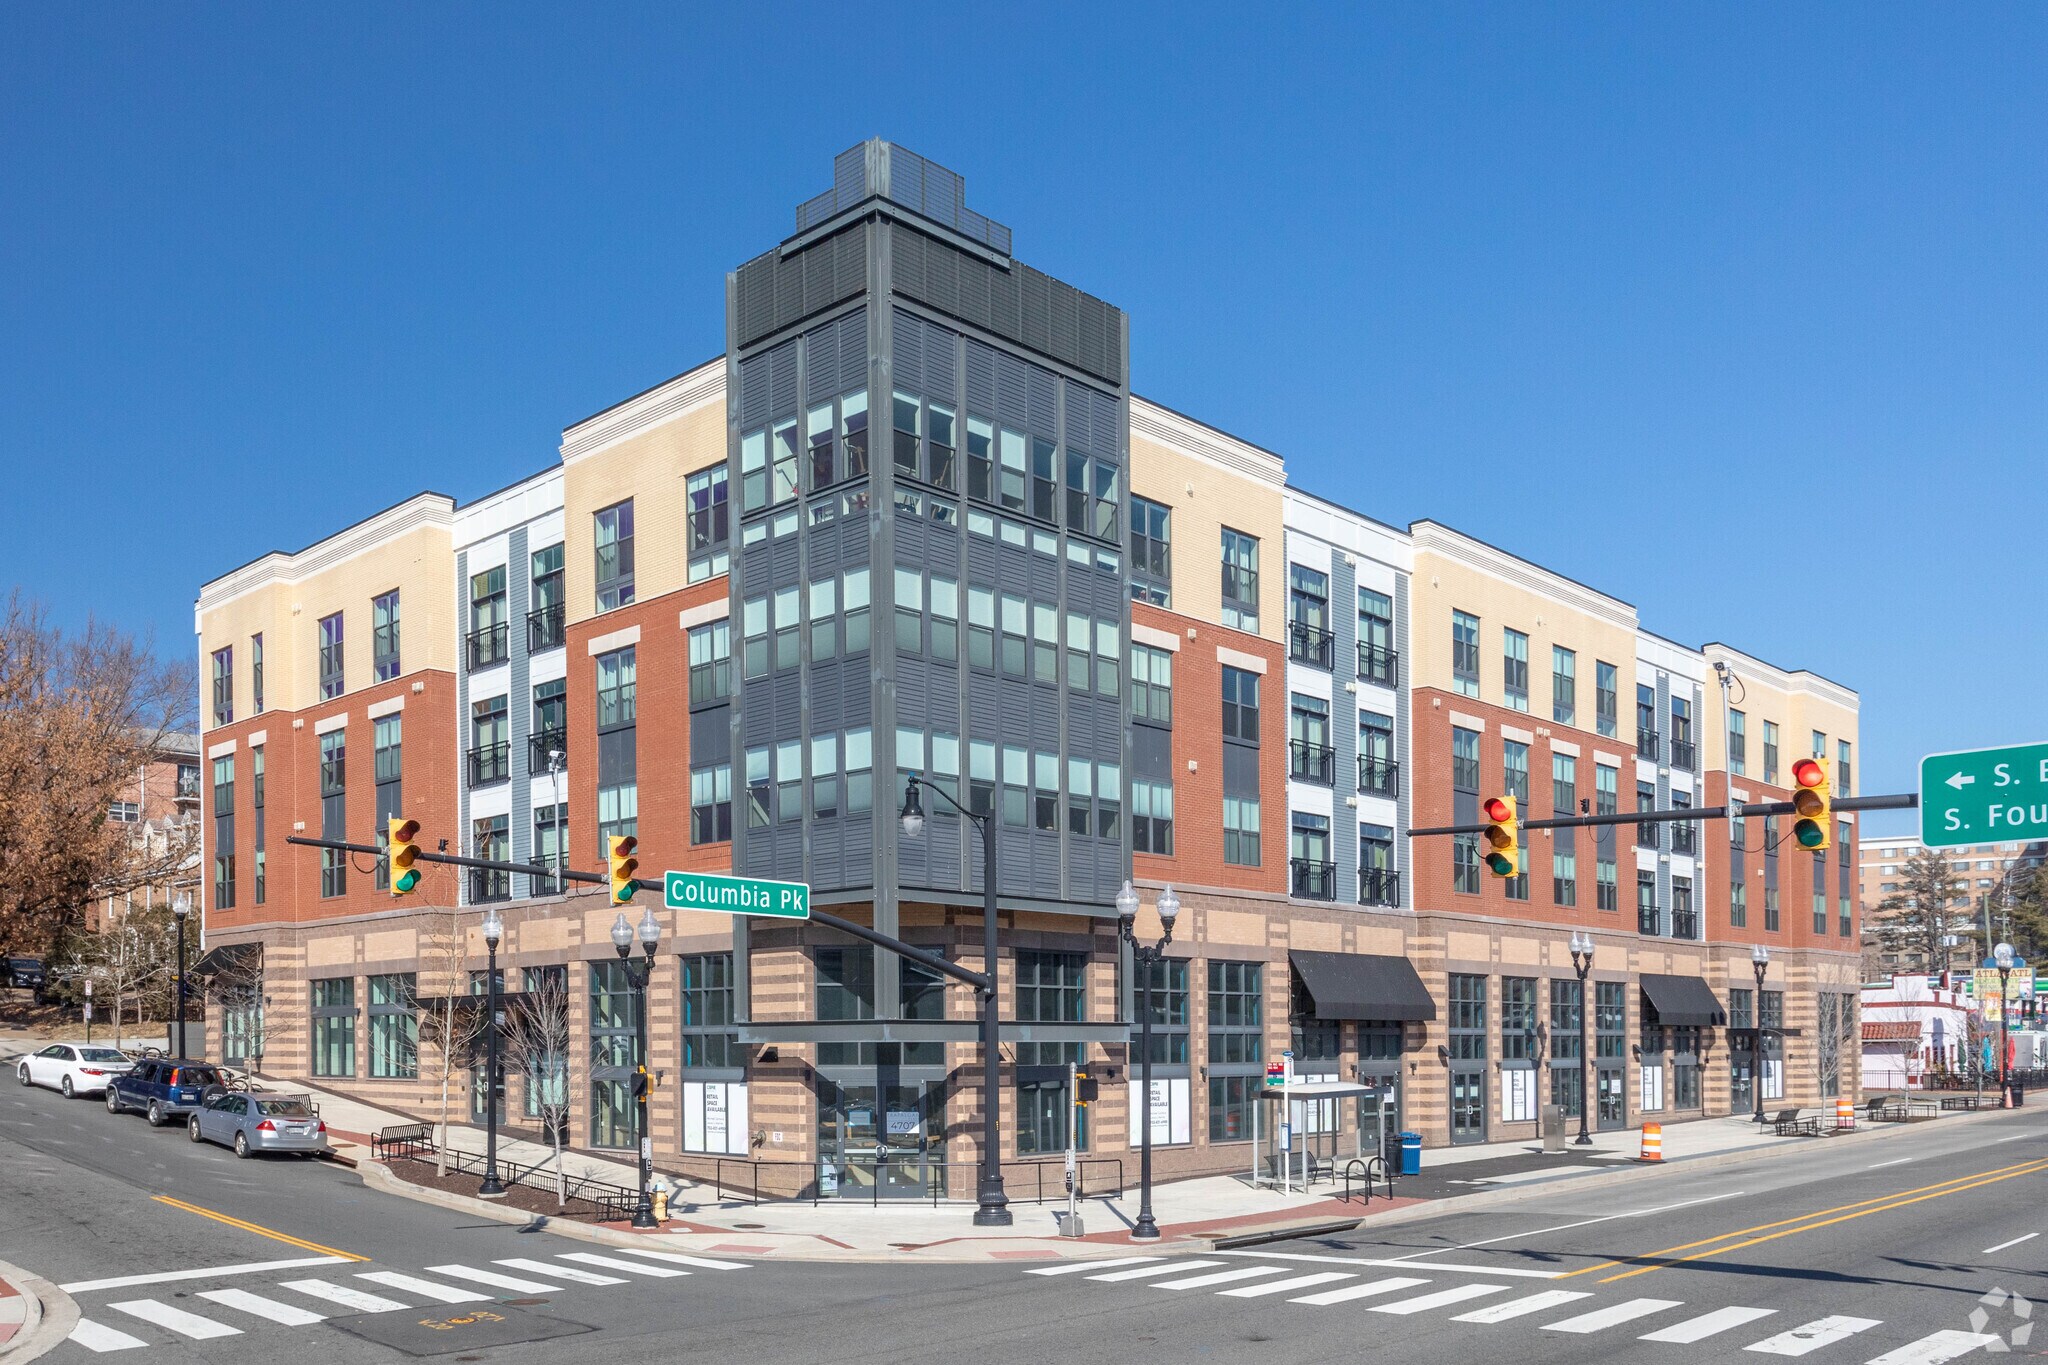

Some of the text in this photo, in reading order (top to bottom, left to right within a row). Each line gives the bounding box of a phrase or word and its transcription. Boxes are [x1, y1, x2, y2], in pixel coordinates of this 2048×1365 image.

[1993, 763, 2021, 787] S.
[1944, 803, 2048, 831] S. Fou
[671, 879, 803, 911] Columbia Pk
[891, 1121, 915, 1130] 4707
